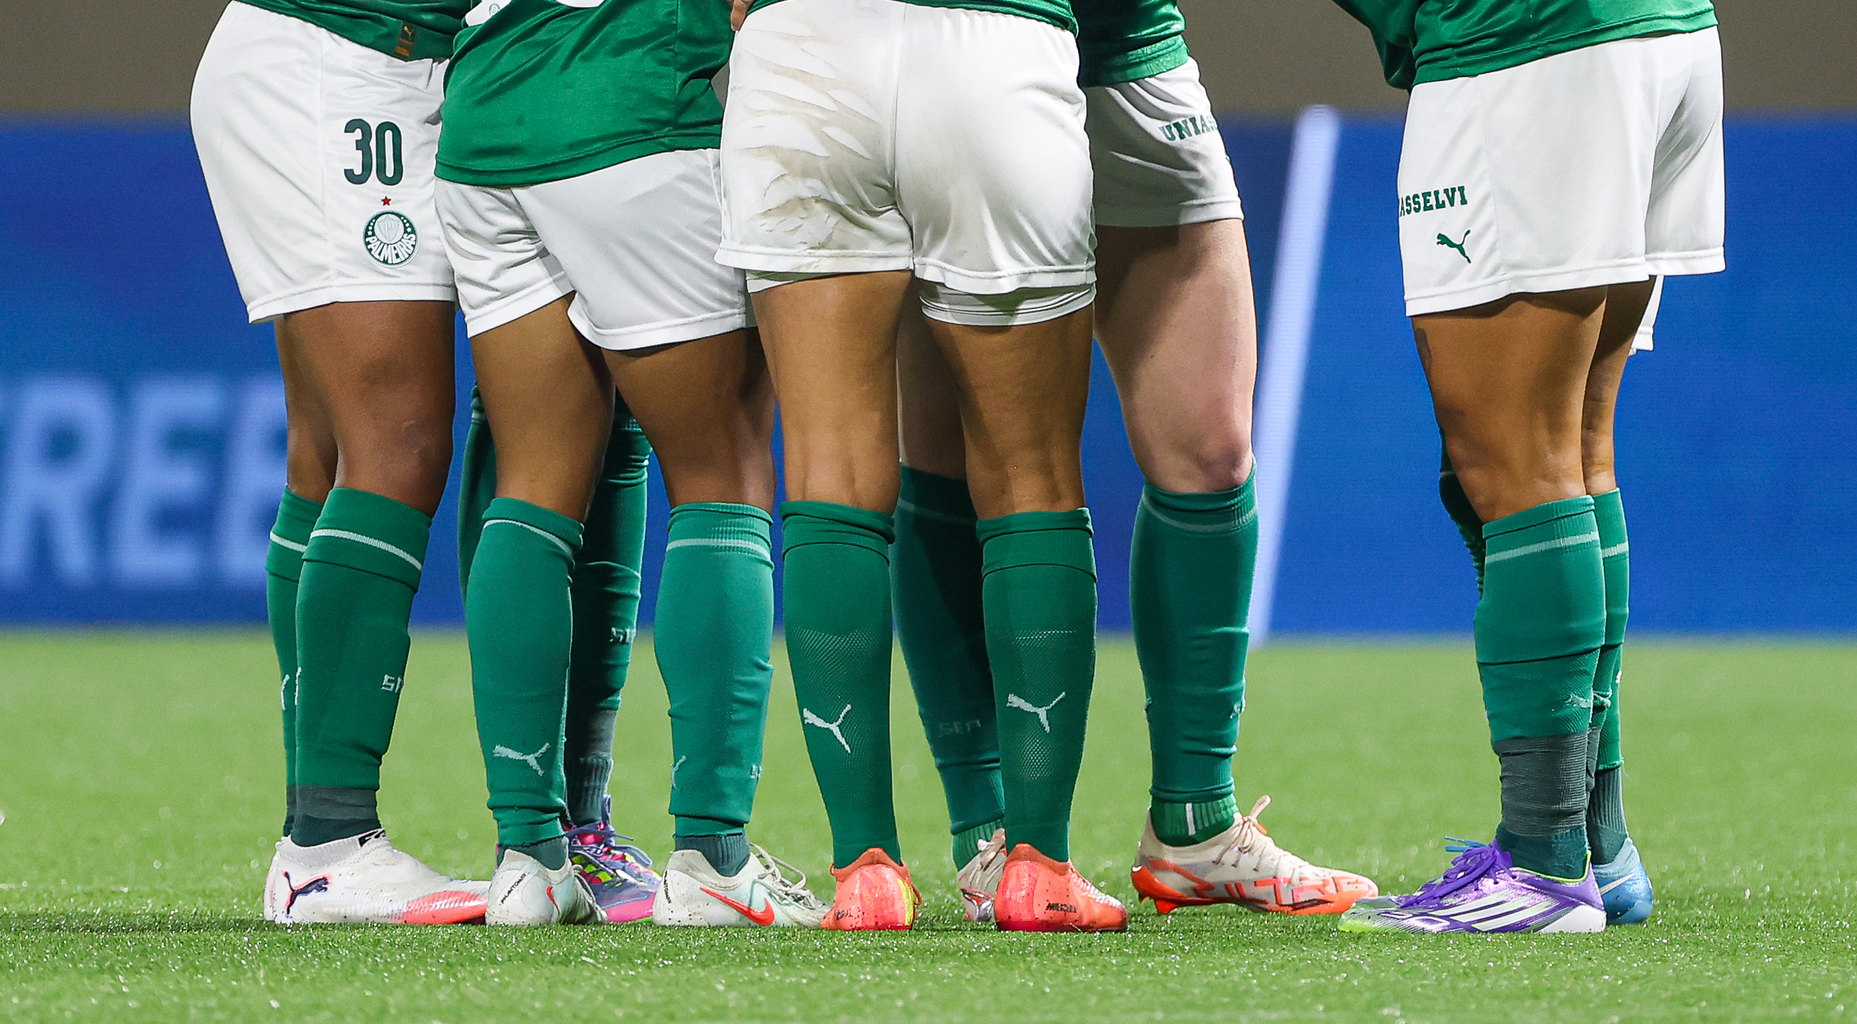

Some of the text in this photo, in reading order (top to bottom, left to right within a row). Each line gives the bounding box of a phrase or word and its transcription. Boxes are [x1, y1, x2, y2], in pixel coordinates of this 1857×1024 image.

[343, 118, 404, 186] 30
[365, 232, 417, 265] PALMEIRAS
[0, 373, 288, 588] REE
